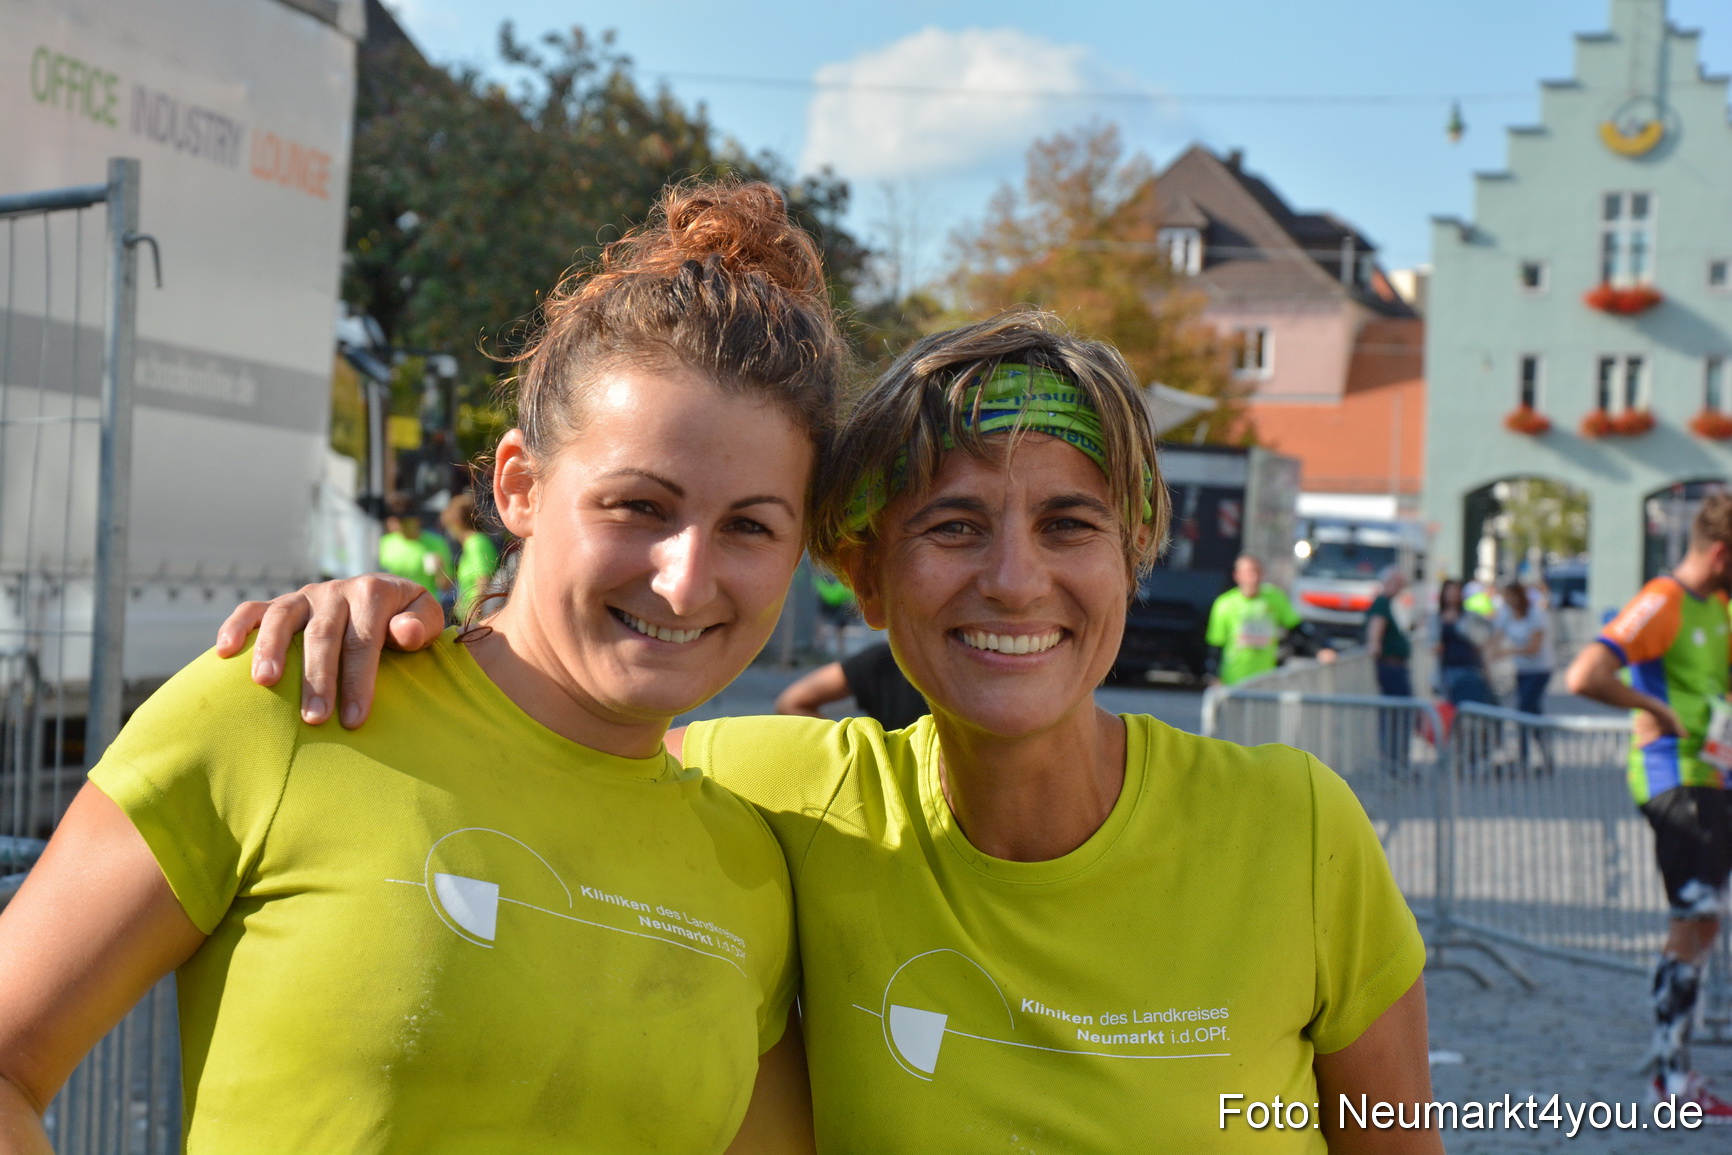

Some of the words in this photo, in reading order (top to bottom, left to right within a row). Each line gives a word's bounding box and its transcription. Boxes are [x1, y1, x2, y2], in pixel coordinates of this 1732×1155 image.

[31, 46, 119, 127] OFFICE
[130, 82, 243, 168] INDUSTRY
[252, 129, 332, 200] LOUNGE
[580, 885, 651, 913] Kliniken
[656, 905, 681, 920] des
[638, 915, 714, 946] Neumarkt
[1021, 998, 1093, 1025] Kliniken
[1099, 1012, 1128, 1026] des
[1133, 1006, 1229, 1024] Landkreises
[1077, 1029, 1165, 1044] Neumarkt
[1171, 1026, 1230, 1044] i.d.OPf.
